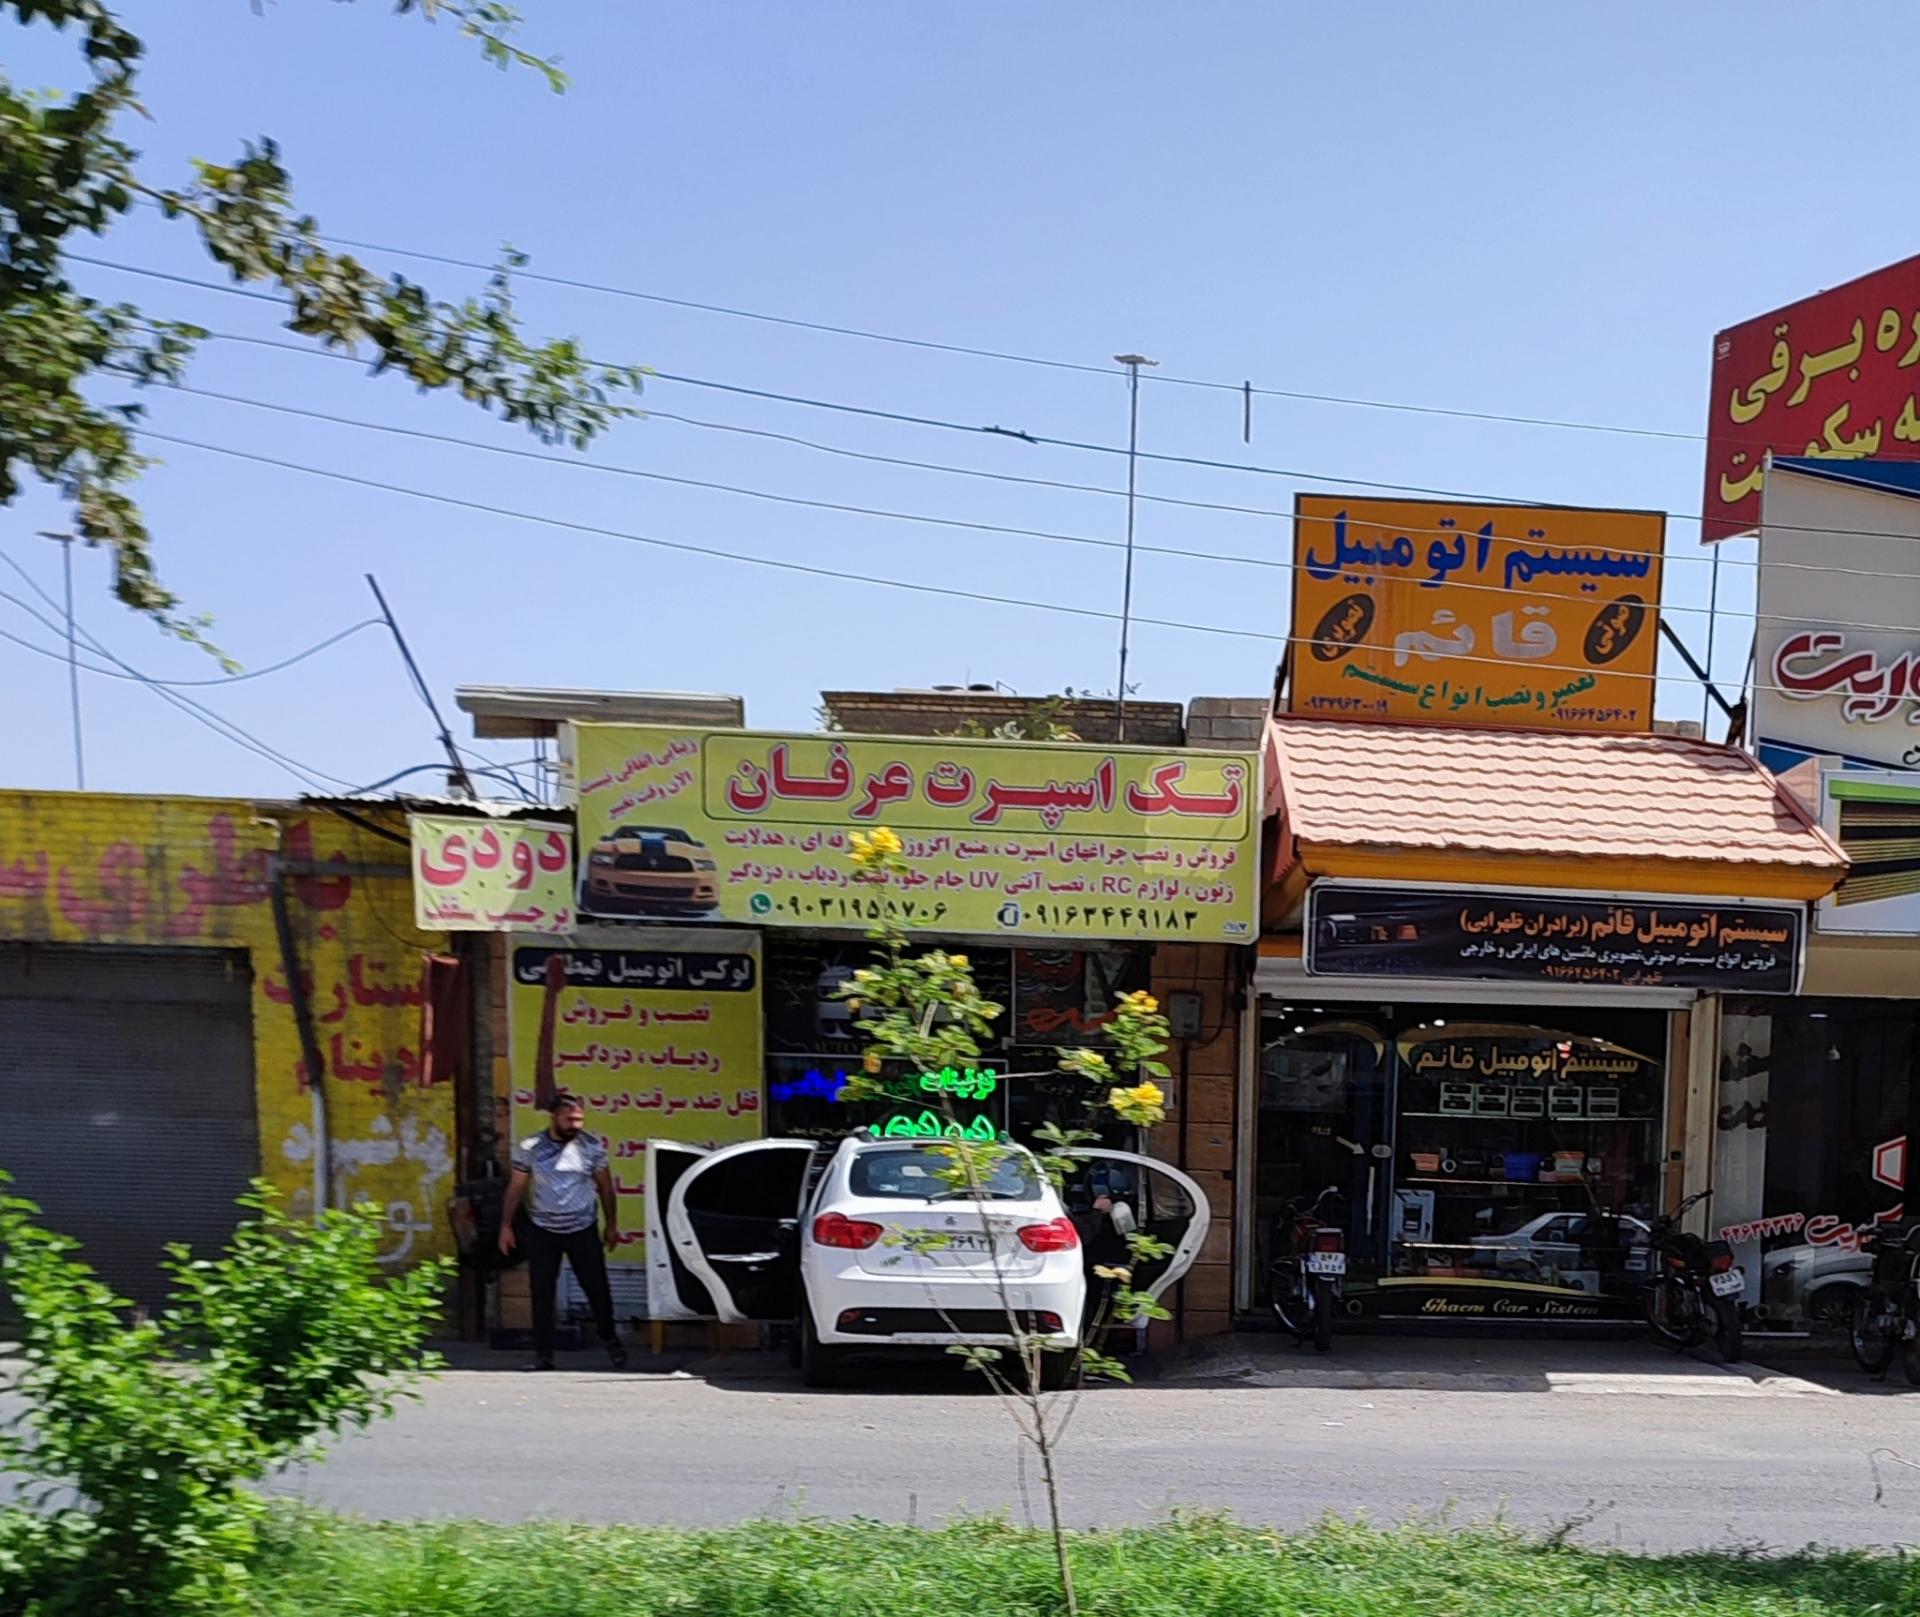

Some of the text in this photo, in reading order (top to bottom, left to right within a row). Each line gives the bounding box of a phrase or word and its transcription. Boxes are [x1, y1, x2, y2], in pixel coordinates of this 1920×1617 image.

[1729, 316, 1866, 424] برقی
[1504, 527, 1652, 592] سیستم
[1536, 690, 1547, 710] و
[726, 742, 1246, 830] تک اسپرت عرفان
[801, 831, 823, 853] ای
[419, 825, 569, 889] دودی
[1132, 848, 1170, 866] نصب
[1172, 854, 1183, 868] و
[1187, 847, 1237, 870] فروش
[970, 871, 1000, 889] UV
[1101, 877, 1133, 894] RC
[1137, 879, 1180, 901] لوازم
[1195, 880, 1235, 904] زنون
[1591, 906, 1635, 942] قائم
[1637, 910, 1718, 947] اتومبیل
[1719, 918, 1789, 949] سیستم
[688, 955, 751, 987] لوکس
[562, 997, 711, 1027] نصب و فروش
[650, 1045, 721, 1073] ردیاب
[1479, 1044, 1559, 1079] اتومبیل
[1560, 1053, 1642, 1080] سیستم
